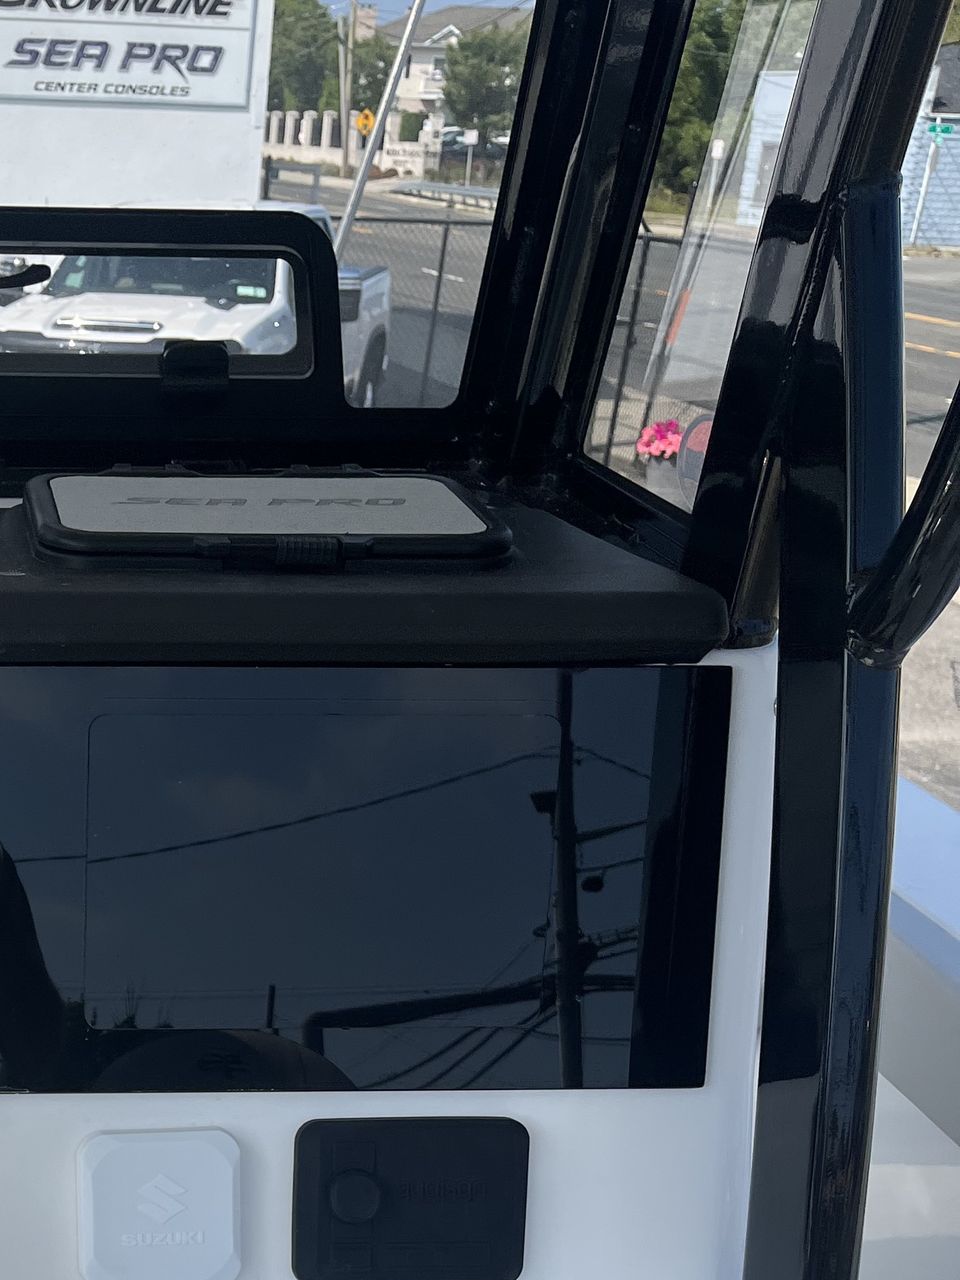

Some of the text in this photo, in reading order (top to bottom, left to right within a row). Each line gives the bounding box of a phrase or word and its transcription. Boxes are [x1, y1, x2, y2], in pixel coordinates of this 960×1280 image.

[3, 37, 225, 84] SEA PRO
[33, 80, 191, 97] CENTER CONSOLES
[120, 1231, 206, 1248] SUZUKI
